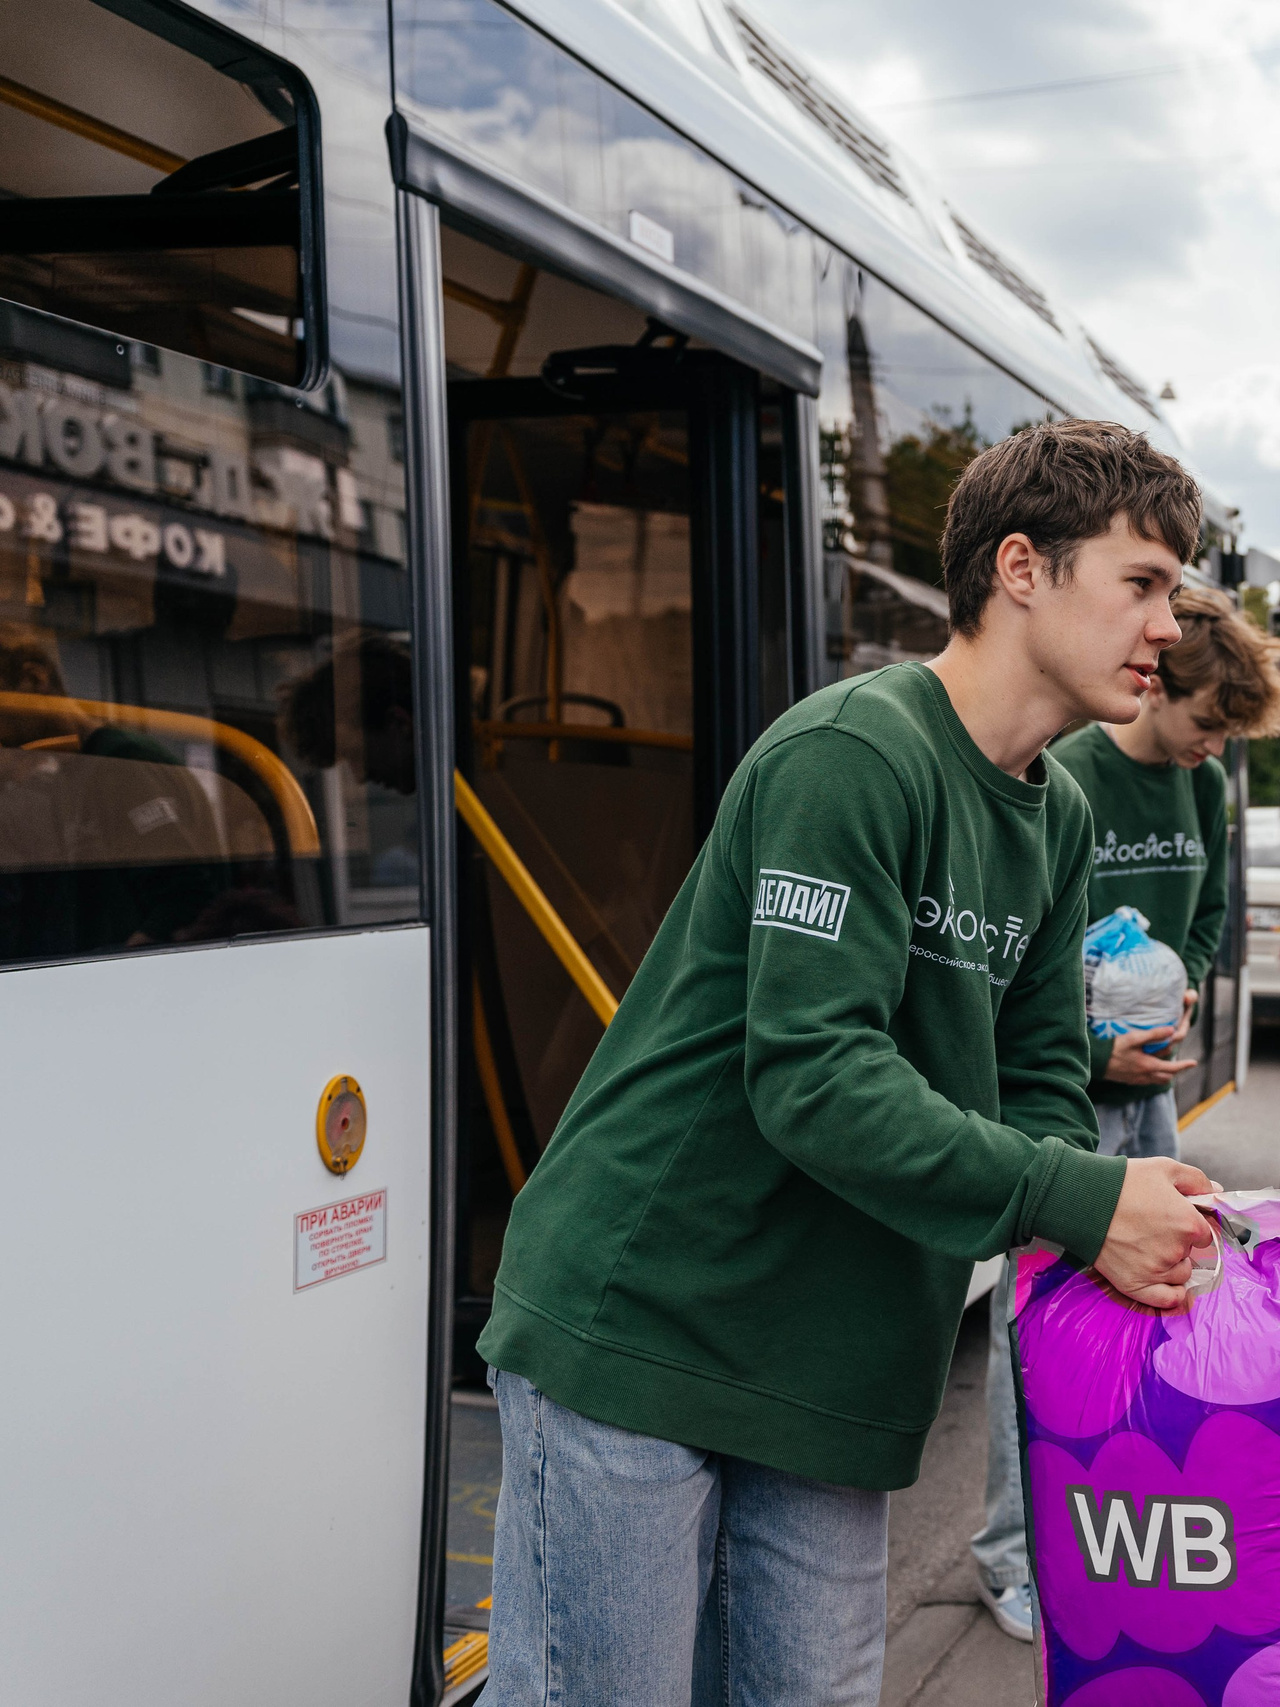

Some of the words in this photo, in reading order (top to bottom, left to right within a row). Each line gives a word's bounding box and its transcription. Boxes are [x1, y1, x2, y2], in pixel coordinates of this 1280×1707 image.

[754, 879, 841, 930] ДЕЛАЙ!
[909, 944, 976, 971] ероссийское
[300, 1210, 327, 1233] ПРИ
[330, 1195, 382, 1224] АВАРИИ
[310, 1232, 353, 1252] ПОВЕРНУТЬ
[319, 1248, 330, 1258] ПО
[311, 1254, 346, 1272] ОТКРЫТЬ
[347, 1245, 371, 1260] ДВЕРИ
[1072, 1491, 1234, 1586] WB
